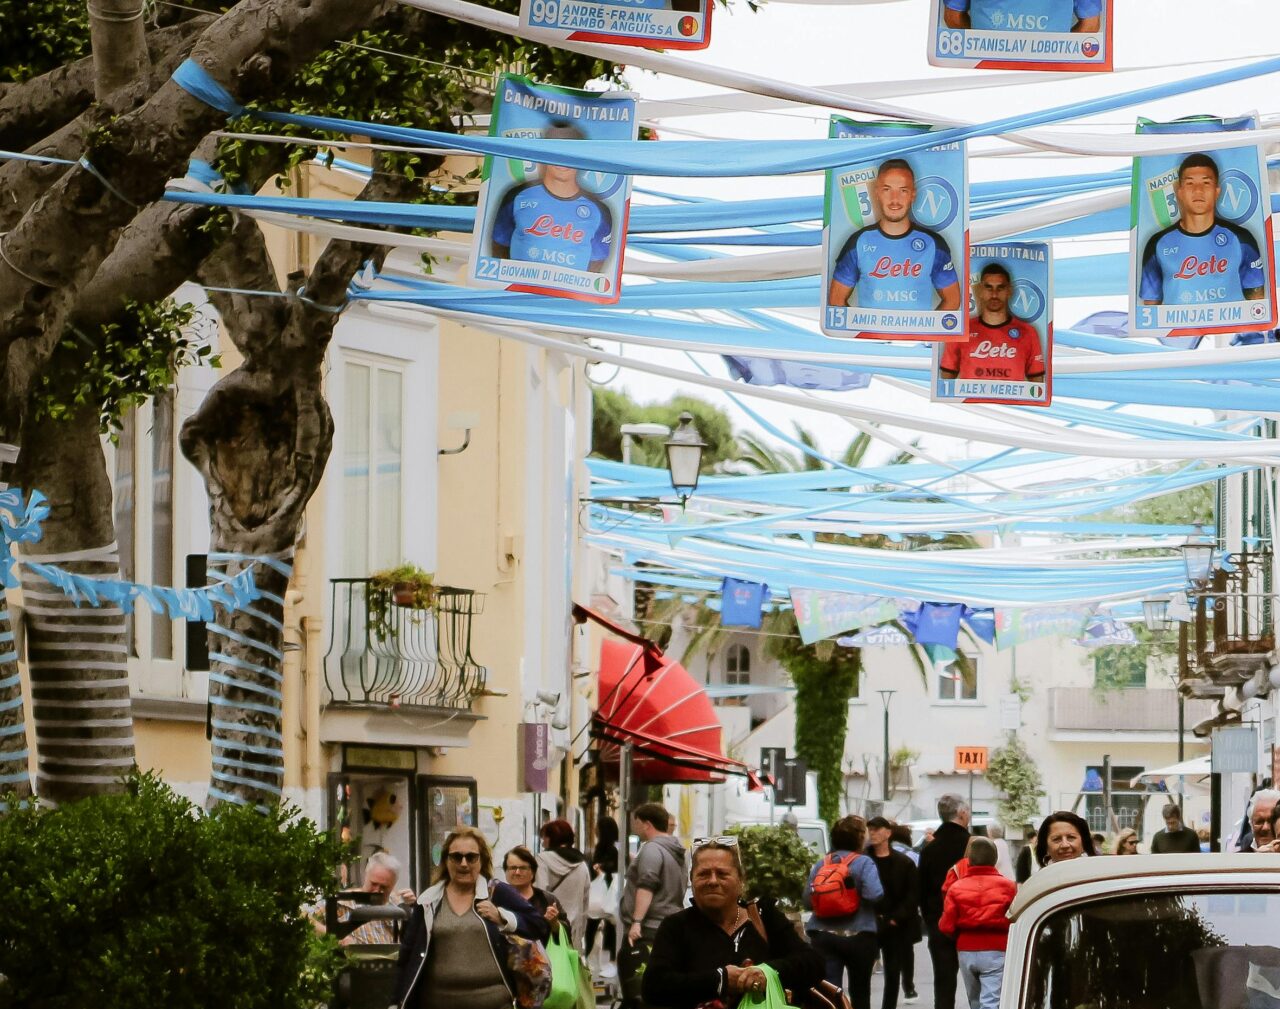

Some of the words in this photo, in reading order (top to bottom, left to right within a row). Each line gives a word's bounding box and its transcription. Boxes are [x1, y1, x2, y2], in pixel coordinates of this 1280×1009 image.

[532, 0, 558, 24] 99
[562, 5, 653, 23] ANDRÉ-FRANK
[561, 14, 605, 29] ZAMBO
[611, 22, 673, 36] ANGUISSA
[1006, 14, 1049, 30] MSC
[939, 31, 963, 55] 68
[966, 38, 1027, 53] STANISLAV
[1032, 40, 1080, 54] LOBOTKA
[504, 90, 569, 116] CAMPIONI
[573, 106, 630, 121] D'ITALIA
[841, 172, 875, 186] NAPOLI
[858, 192, 872, 216] 3
[1166, 193, 1179, 218] 3
[524, 214, 585, 243] Lete
[542, 249, 576, 265] MSC
[970, 246, 998, 258] PIONI
[1001, 248, 1045, 262] D'ITALIA
[1164, 247, 1179, 255] EA7
[478, 260, 499, 278] 22
[501, 265, 541, 279] GIOVANNI
[543, 270, 551, 281] DI
[554, 272, 591, 287] LORENZO
[869, 256, 922, 279] Lete
[1174, 255, 1228, 280] Lete
[887, 290, 918, 302] MSC
[1196, 288, 1226, 302] MSC
[828, 308, 845, 328] 13
[852, 314, 877, 325] AMIR
[881, 316, 935, 327] RRAHMANI
[1142, 308, 1152, 327] 3
[1166, 309, 1214, 323] MINJAE
[1220, 307, 1241, 321] KIM
[970, 341, 1017, 359] Lete
[986, 368, 1012, 377] MSC
[944, 382, 950, 395] 1
[960, 384, 986, 394] ALEX
[990, 385, 1024, 395] MERET
[958, 752, 983, 764] TAXI
